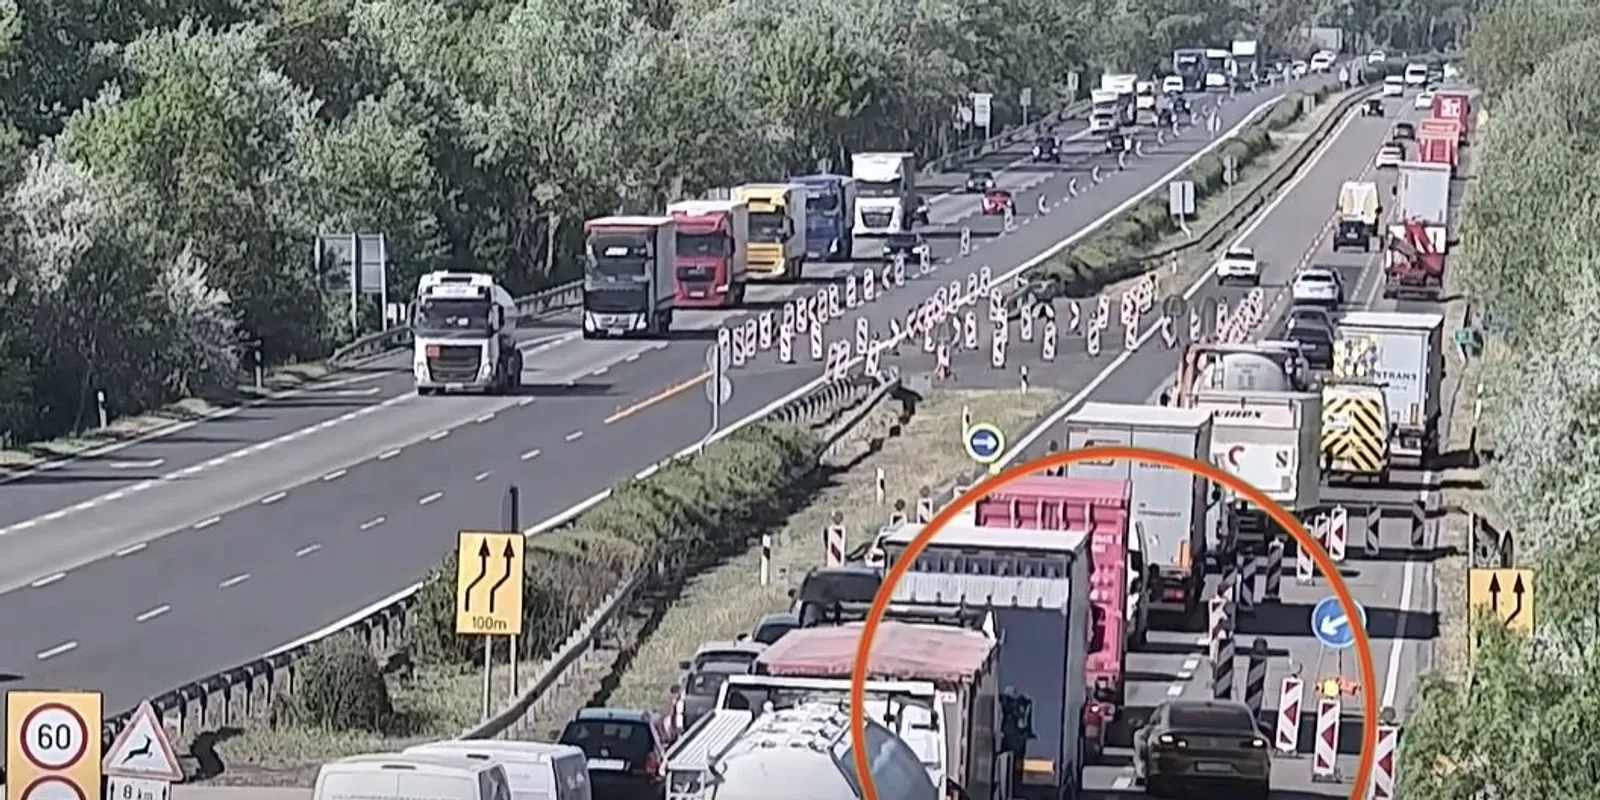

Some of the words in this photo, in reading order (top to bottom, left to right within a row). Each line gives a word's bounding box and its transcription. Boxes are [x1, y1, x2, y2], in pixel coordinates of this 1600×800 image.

[472, 616, 507, 630] 100m
[38, 723, 71, 750] 60
[123, 785, 132, 799] 8
